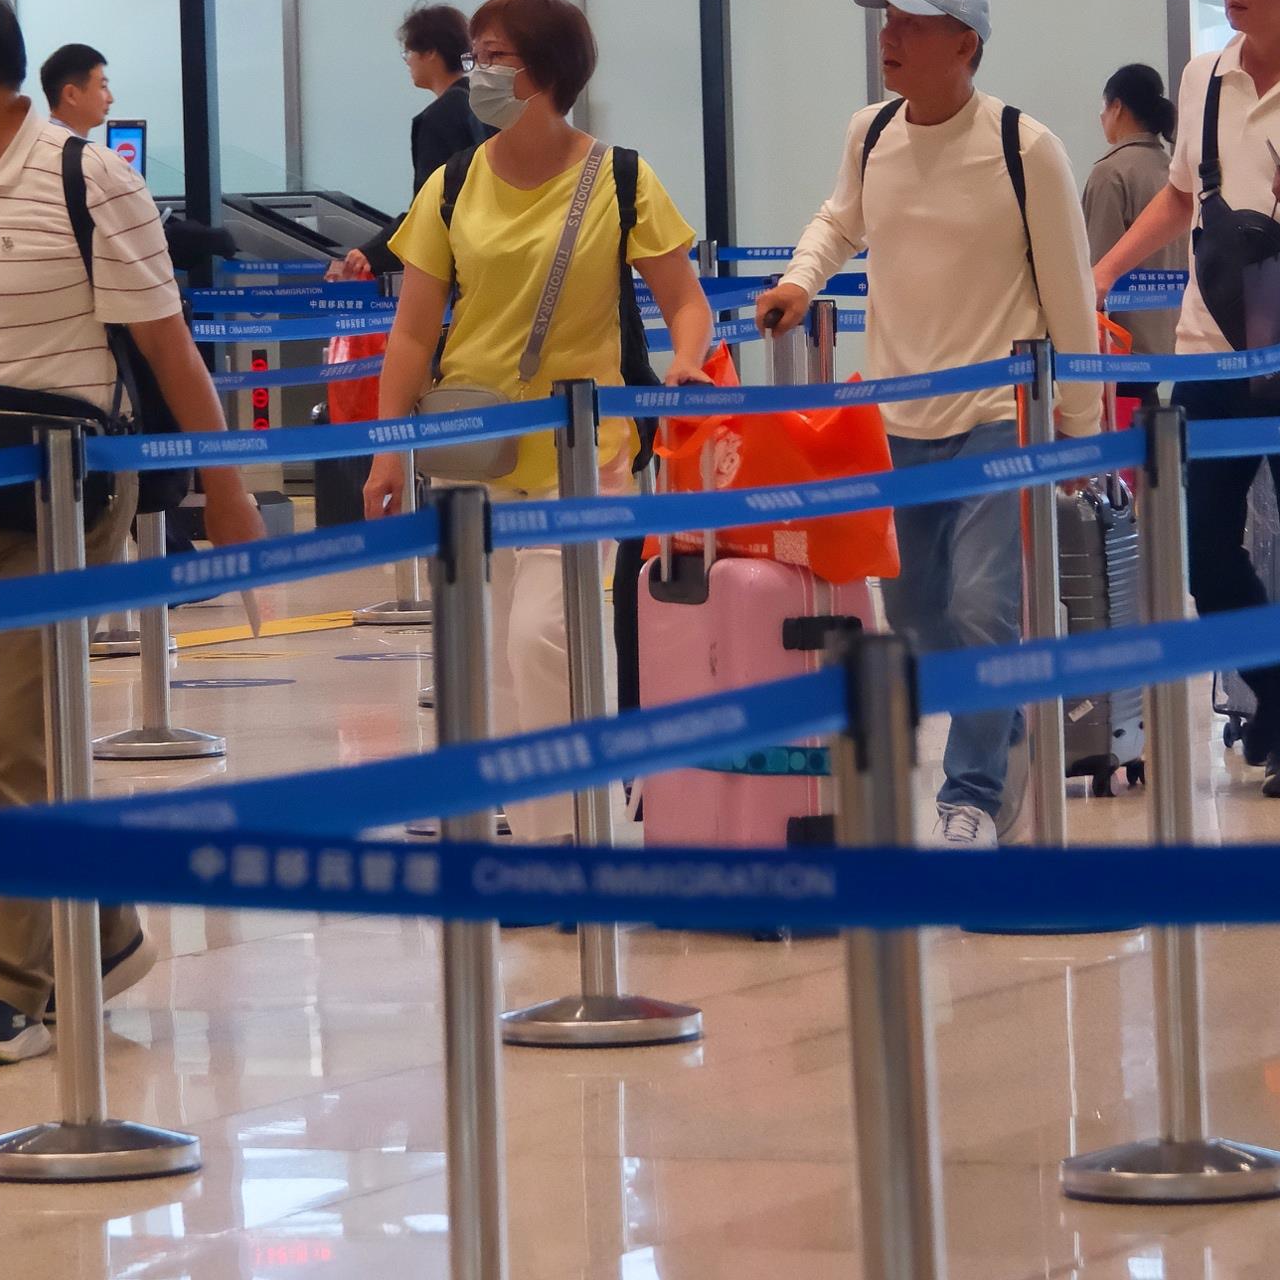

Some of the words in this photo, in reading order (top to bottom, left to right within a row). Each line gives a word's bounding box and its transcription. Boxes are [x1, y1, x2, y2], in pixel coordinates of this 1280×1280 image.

[309, 300, 363, 309] 中国移民管理
